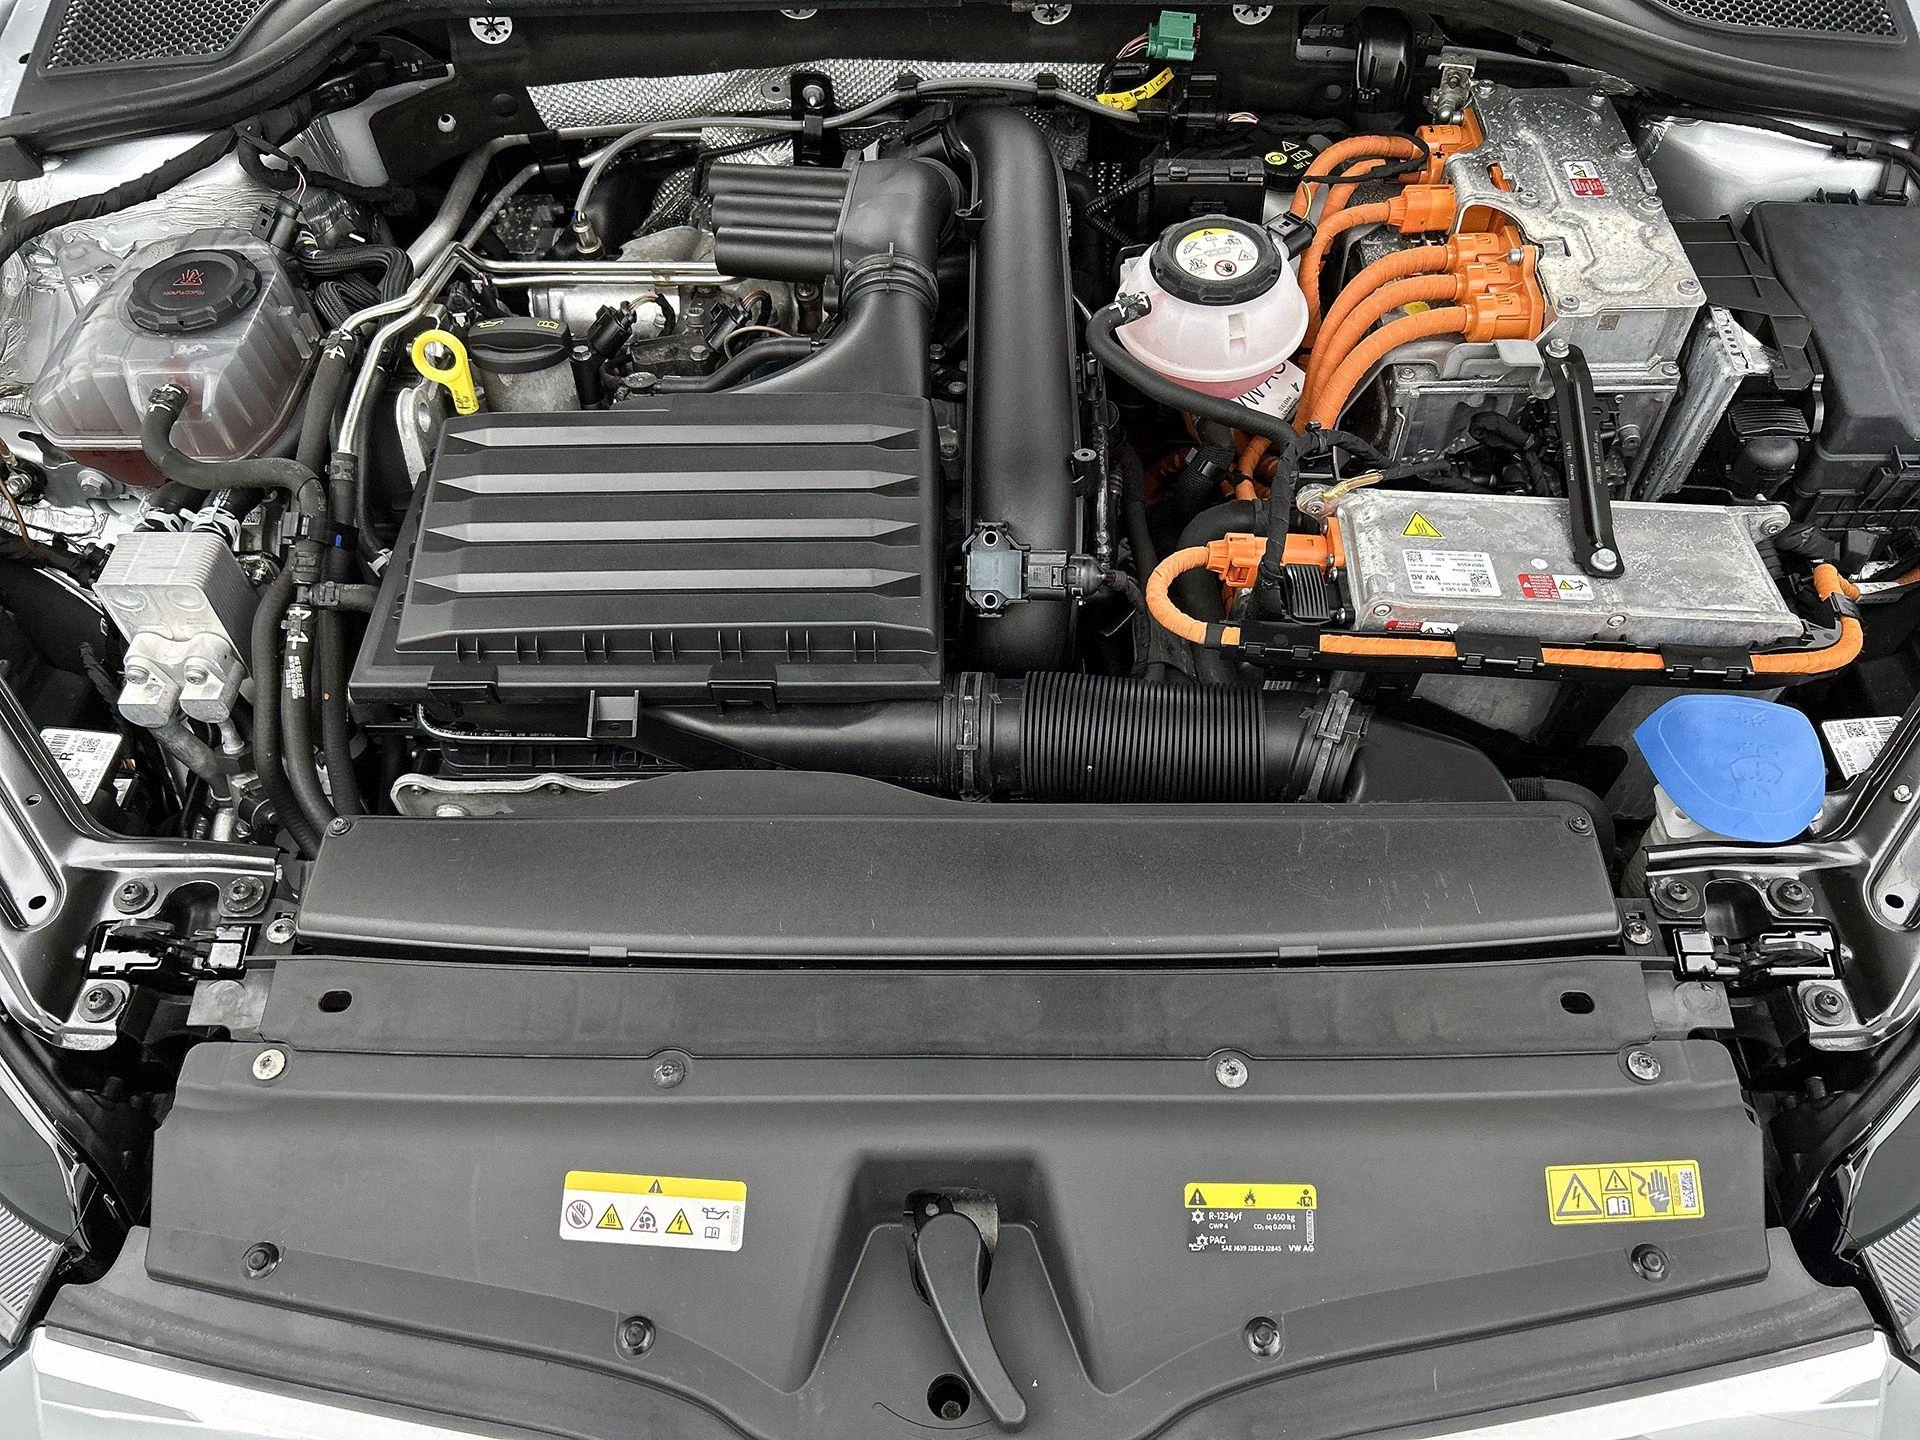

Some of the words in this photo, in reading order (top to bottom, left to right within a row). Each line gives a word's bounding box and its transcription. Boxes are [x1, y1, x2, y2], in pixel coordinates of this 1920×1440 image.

[59, 752, 74, 761] R
[1208, 1211, 1243, 1223] R-1234yf
[1266, 1213, 1286, 1221] 0.450
[1286, 1213, 1296, 1223] kg
[1208, 1222, 1224, 1230] GWP
[1224, 1222, 1229, 1230] 4
[1209, 1235, 1227, 1244] PAG
[1221, 1244, 1233, 1252] SAE
[1233, 1244, 1248, 1252] J639
[1288, 1244, 1302, 1252] VW
[1302, 1244, 1315, 1252] AG
